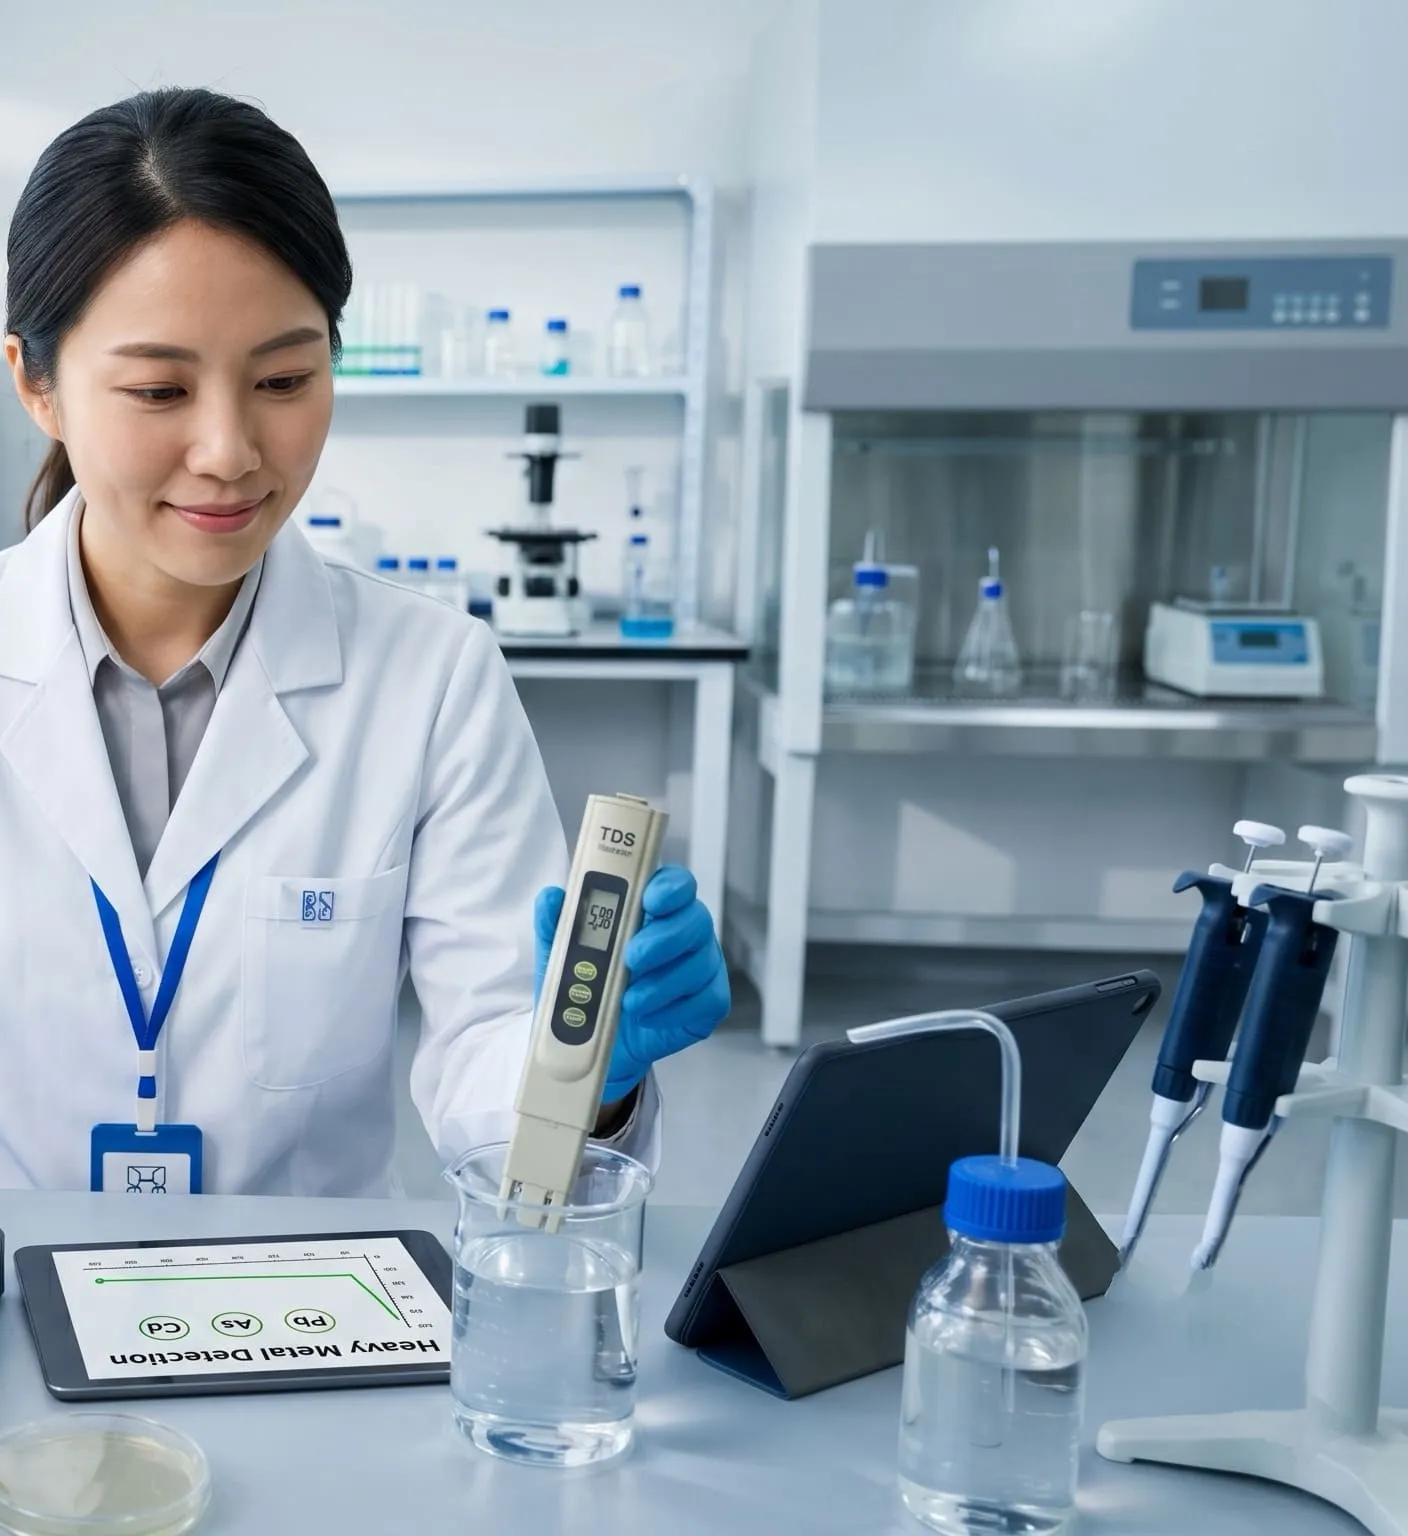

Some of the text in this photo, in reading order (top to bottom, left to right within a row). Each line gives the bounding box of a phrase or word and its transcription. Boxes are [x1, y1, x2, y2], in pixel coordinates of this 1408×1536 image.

[600, 826, 636, 848] TDS
[221, 1318, 252, 1330] As
[293, 1314, 328, 1328] Pb
[147, 1322, 182, 1335] Cd
[109, 1339, 441, 1366] Heavy Metal Detection
